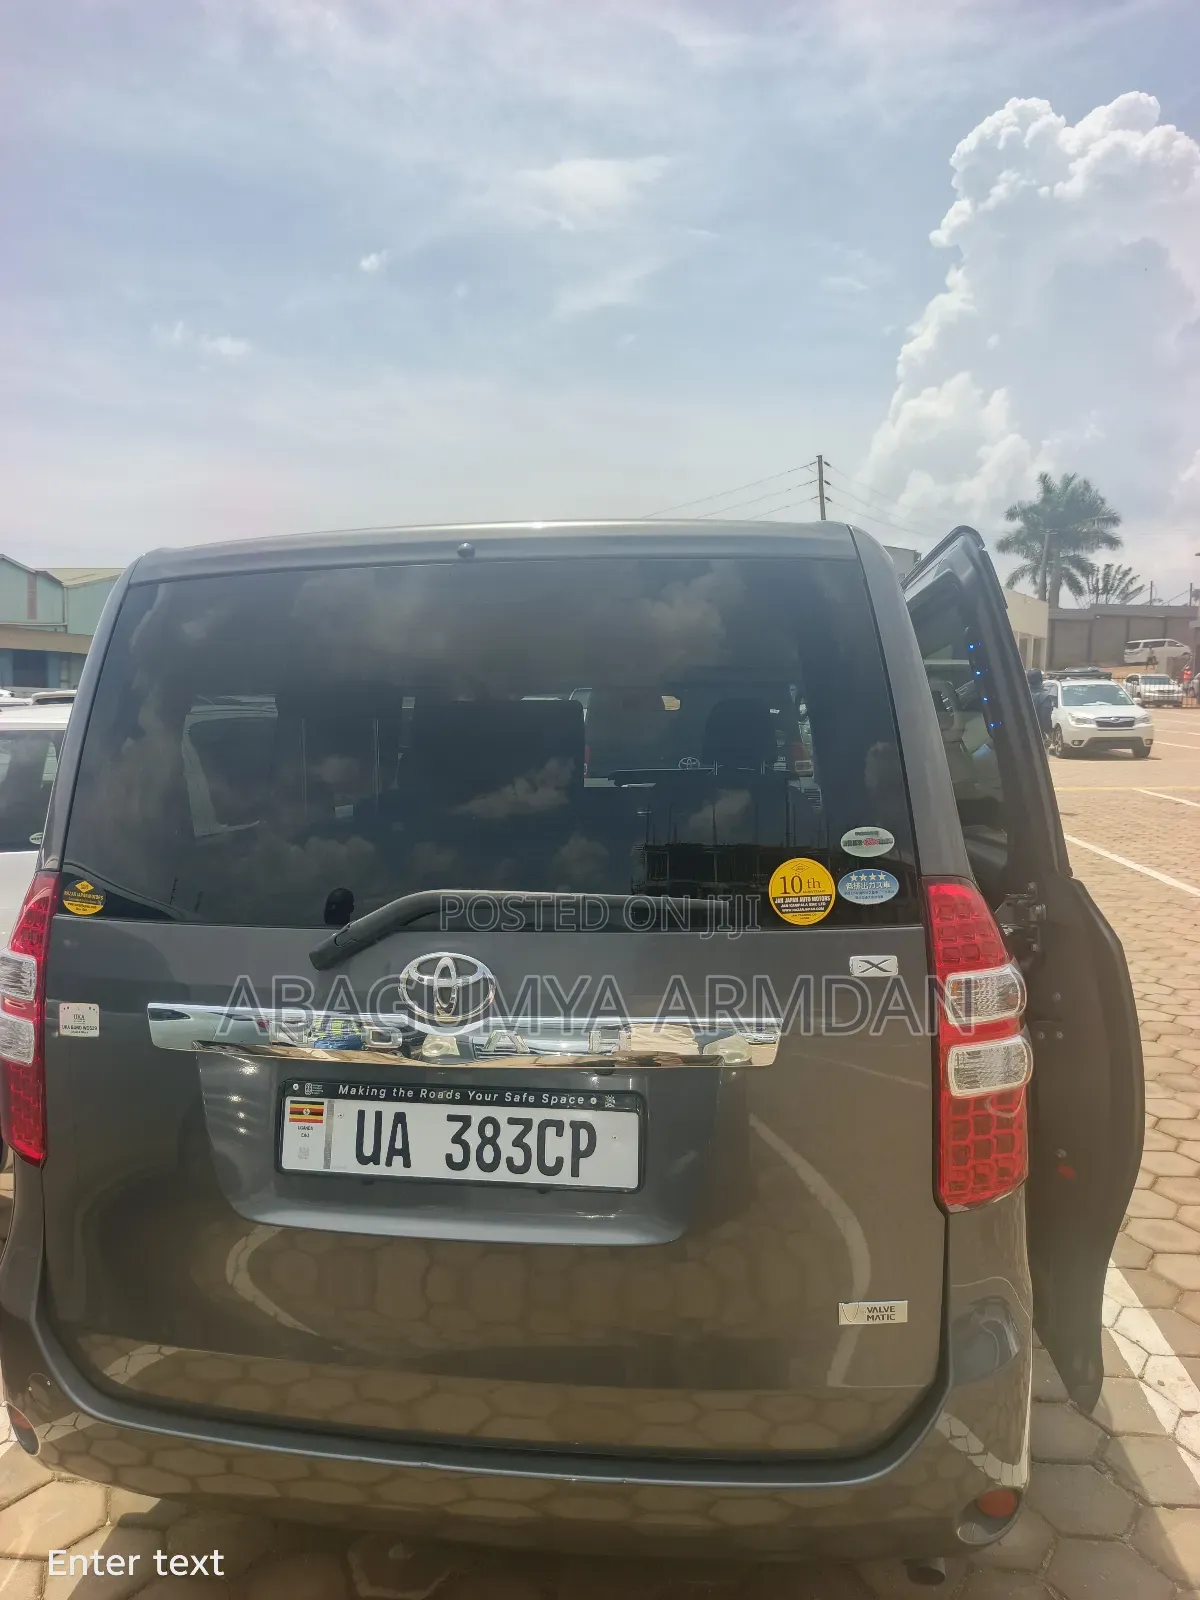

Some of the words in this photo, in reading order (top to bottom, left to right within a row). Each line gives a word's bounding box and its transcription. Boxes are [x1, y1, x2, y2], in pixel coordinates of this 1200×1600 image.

[780, 875, 803, 895] 10
[806, 877, 821, 889] th
[859, 958, 892, 974] X
[338, 1084, 387, 1099] Making
[392, 1086, 414, 1098] the
[419, 1088, 461, 1100] Roads
[467, 1090, 499, 1101] Your
[504, 1091, 535, 1103] Safe
[541, 1093, 585, 1106] Space
[355, 1109, 411, 1168] UA
[444, 1113, 597, 1178] 383CP
[866, 1305, 896, 1313] VALVE
[866, 1313, 896, 1321] MATIC
